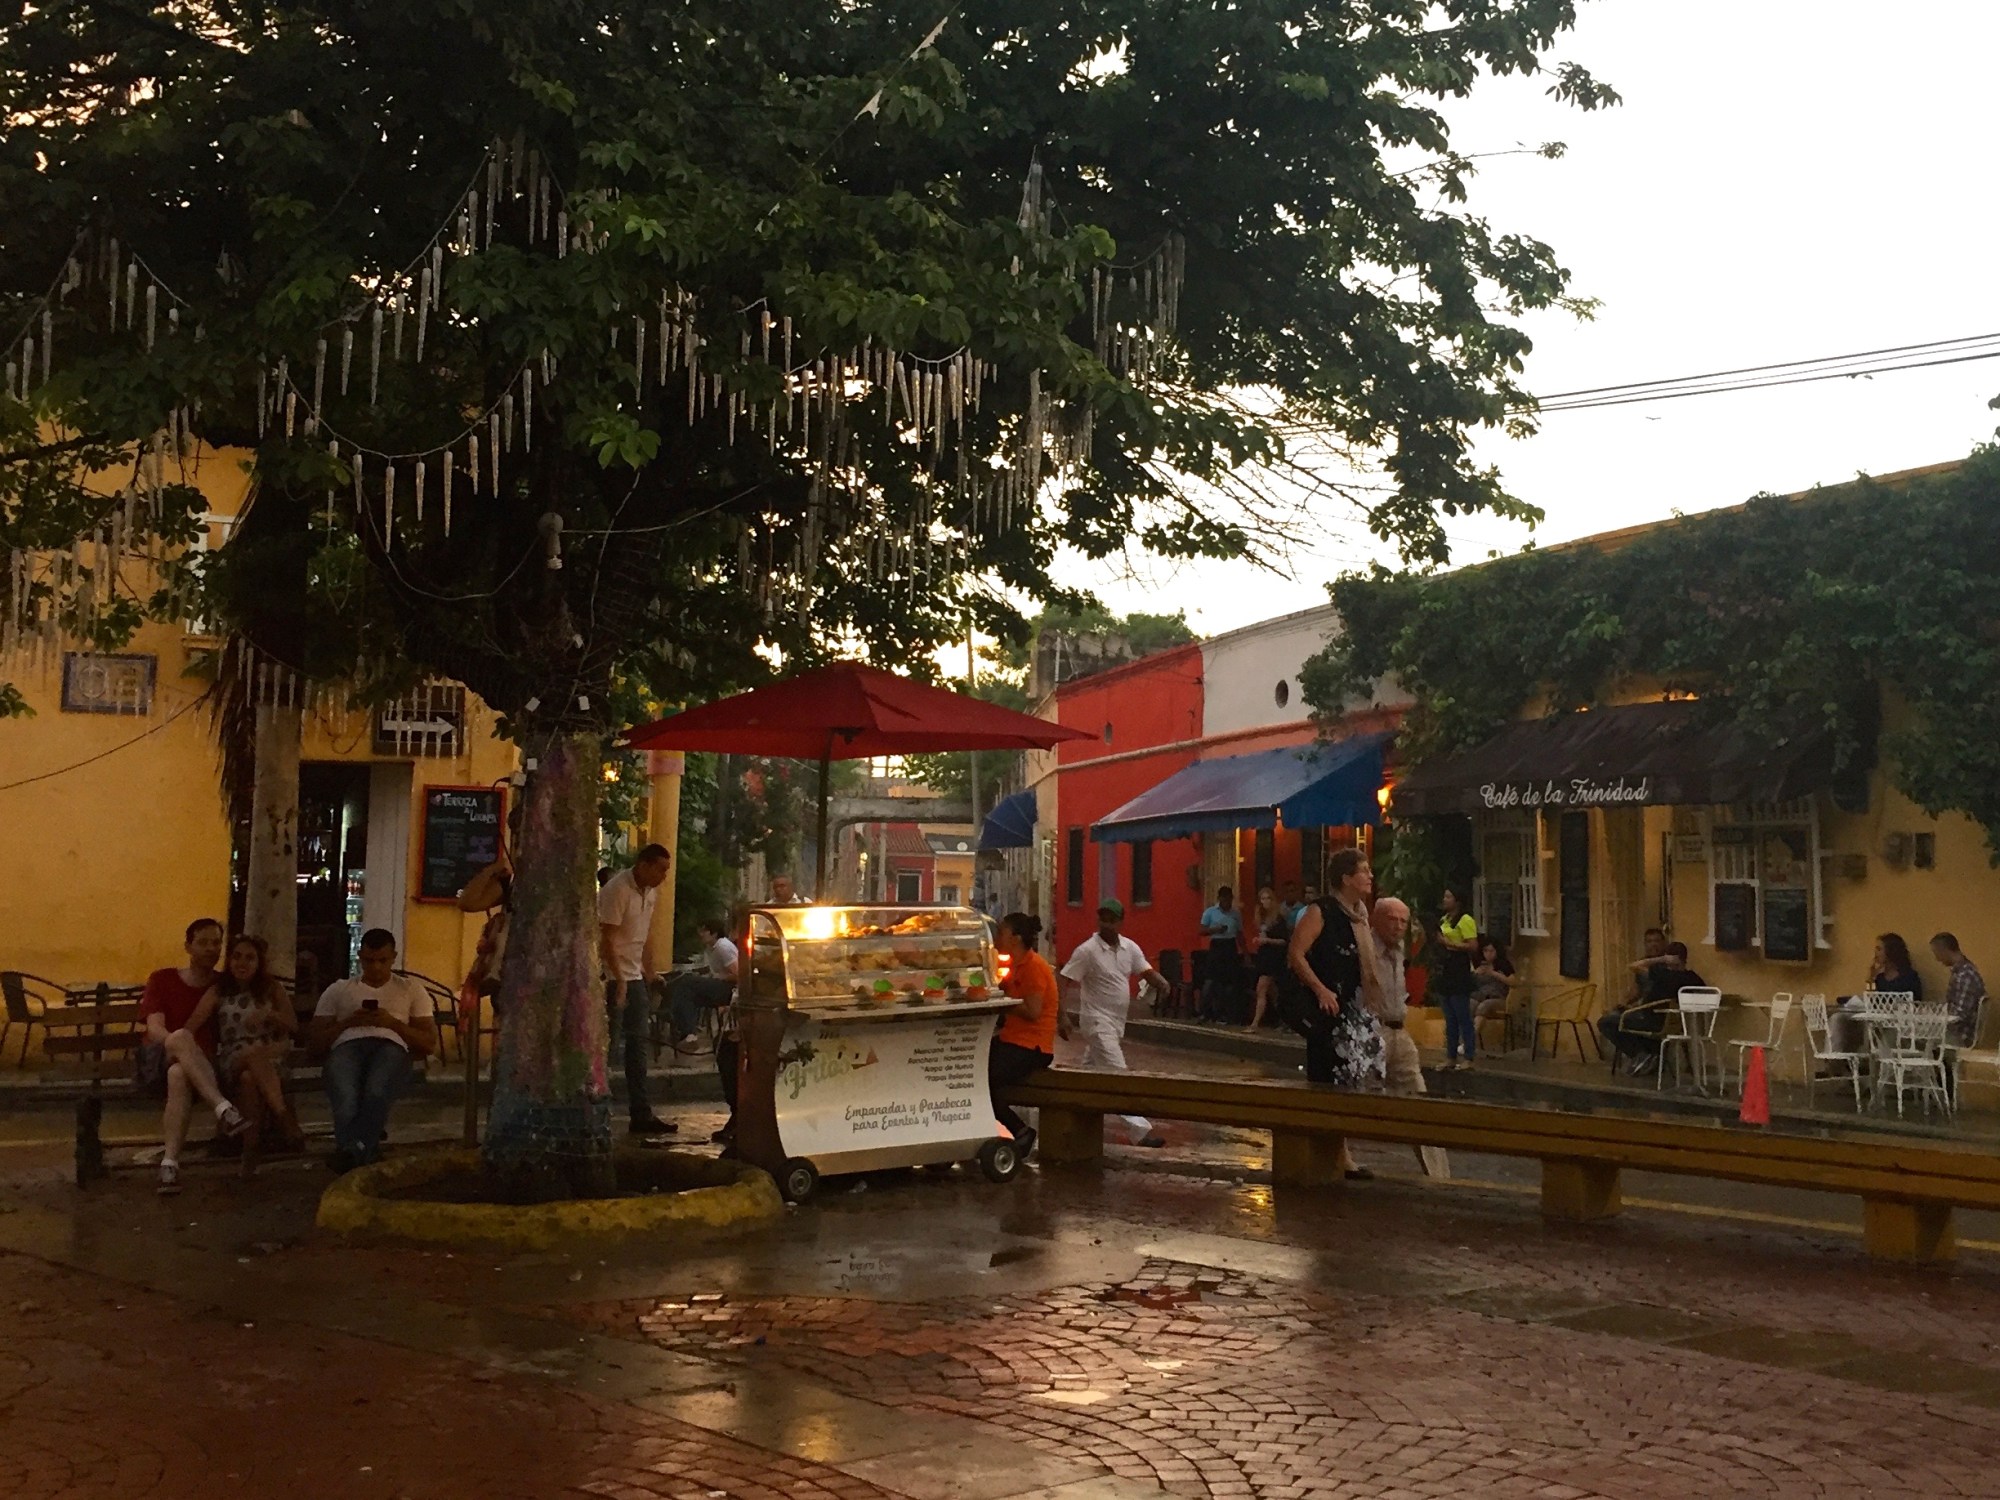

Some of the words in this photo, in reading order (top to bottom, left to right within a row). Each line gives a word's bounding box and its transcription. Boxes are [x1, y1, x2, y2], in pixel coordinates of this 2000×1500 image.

[1480, 782, 1519, 808] Café
[1522, 782, 1542, 805] de
[1544, 780, 1565, 804] la
[1569, 777, 1649, 804] Trinidad
[845, 1102, 907, 1121] Empanadas
[910, 1104, 916, 1115] y
[852, 1119, 879, 1133] para
[881, 1115, 919, 1131] Eventos
[922, 1117, 929, 1127] y
[932, 1110, 972, 1125] Negocio
